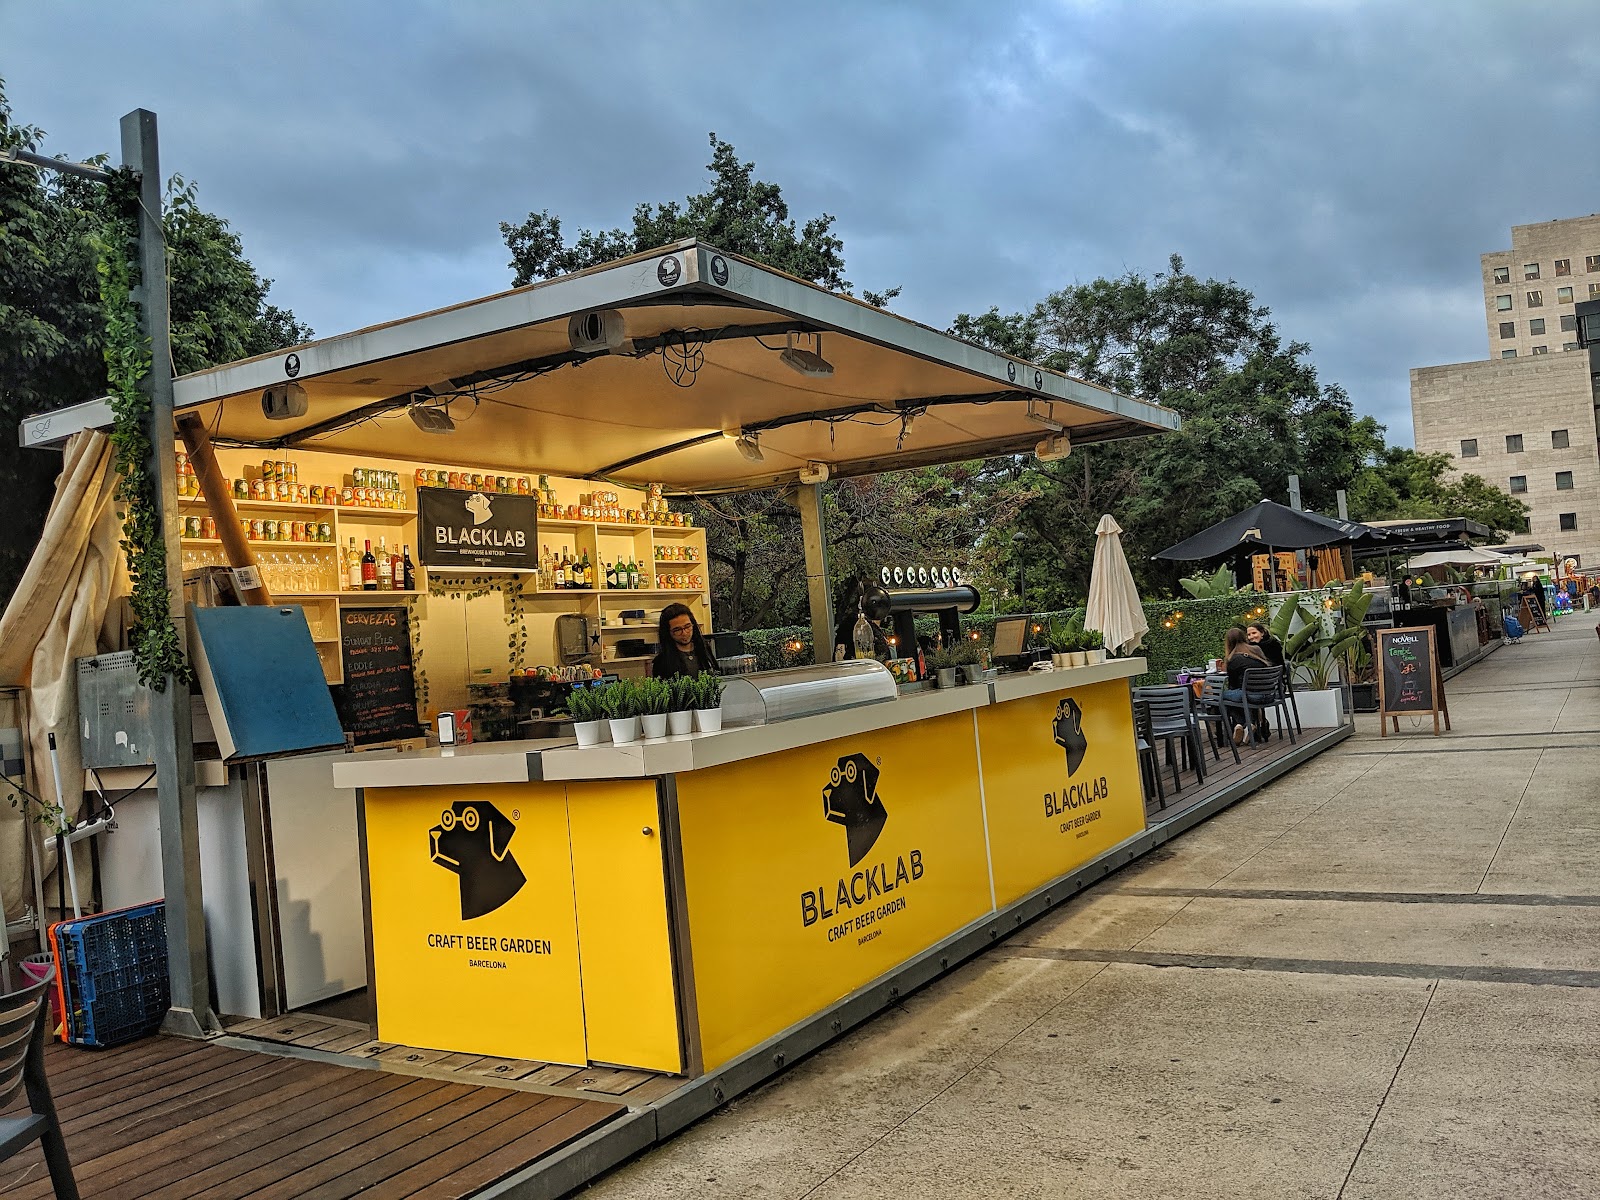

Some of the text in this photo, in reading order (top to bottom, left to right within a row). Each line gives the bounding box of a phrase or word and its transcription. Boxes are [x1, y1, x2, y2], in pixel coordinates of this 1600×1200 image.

[435, 526, 526, 547] BLACKLAB
[345, 613, 397, 626] CERVEZAS
[1044, 777, 1108, 818] BLACKLAB
[1060, 809, 1102, 834] CRAFT BEER GARDEN
[801, 849, 924, 927] BLACKLAB
[828, 896, 906, 942] CRAFT BEER GARDEN
[427, 933, 551, 955] CRAFT BEER GARDEN
[857, 929, 882, 946] BARCELONA
[469, 959, 507, 969] BARCELONA
